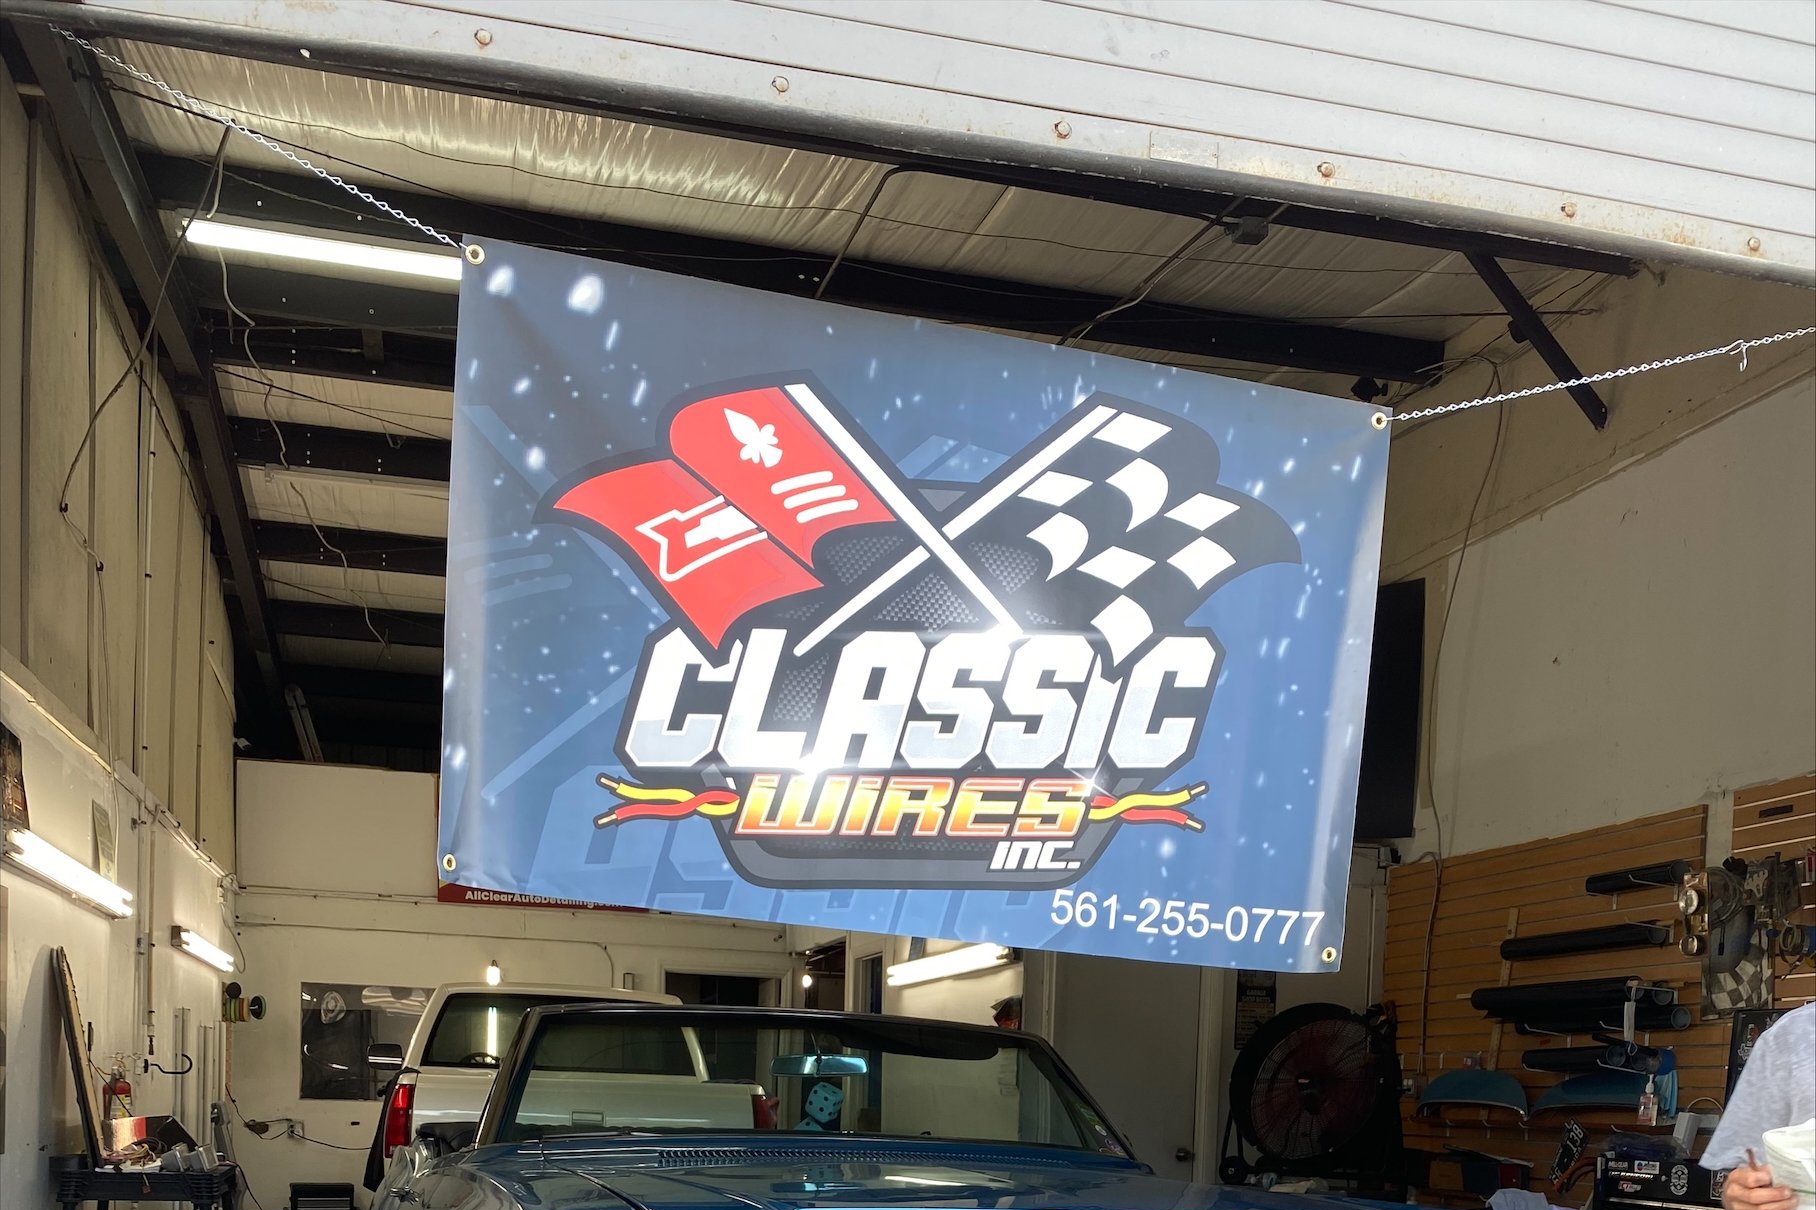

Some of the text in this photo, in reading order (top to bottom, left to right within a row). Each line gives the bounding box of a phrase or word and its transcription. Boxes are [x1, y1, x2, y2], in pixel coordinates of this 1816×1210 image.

[625, 628, 1216, 769] CLASSIC
[735, 773, 1096, 838] WIRES
[989, 840, 1081, 870] INC.
[1051, 888, 1326, 946] 561-255-0777
